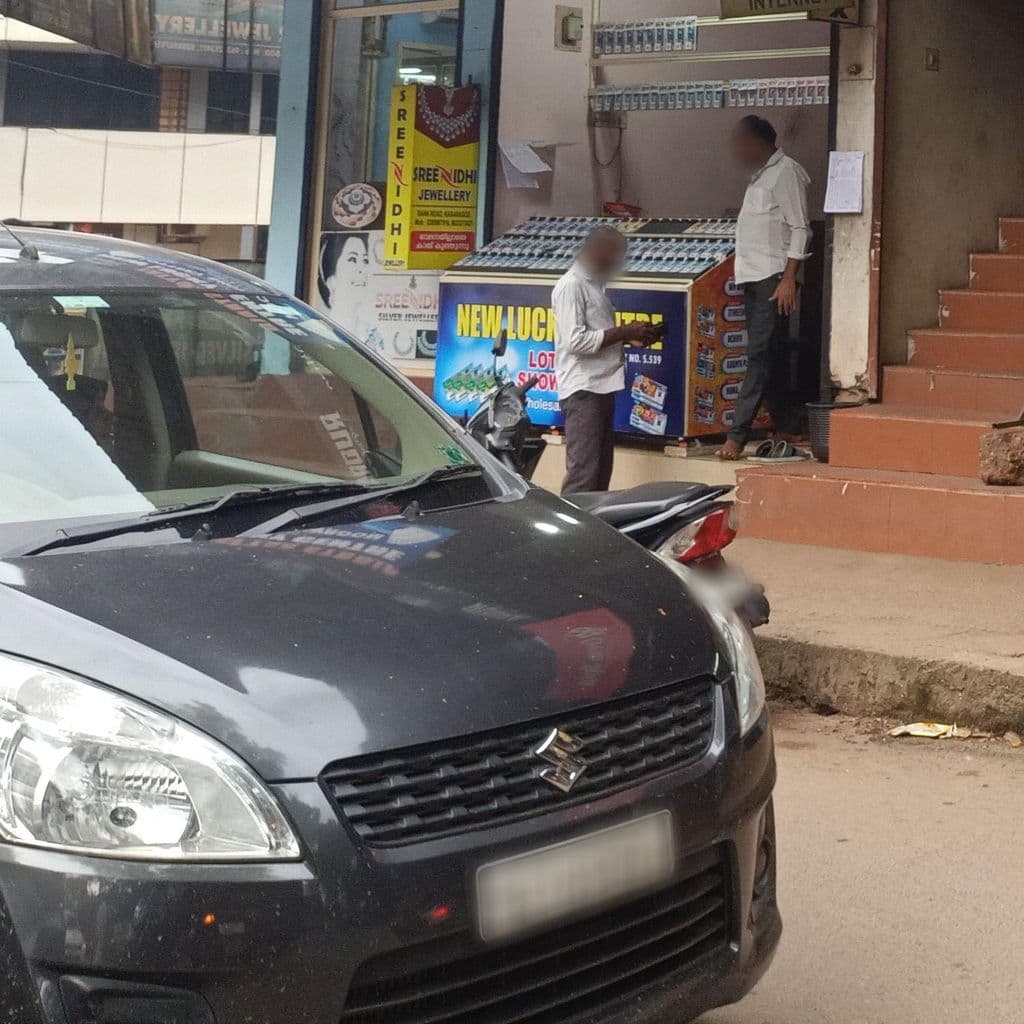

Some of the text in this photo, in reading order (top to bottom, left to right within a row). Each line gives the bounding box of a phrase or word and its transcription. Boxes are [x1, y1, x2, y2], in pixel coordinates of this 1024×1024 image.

[418, 189, 471, 202] JEWELLERY
[456, 303, 502, 338] NEW
[507, 304, 557, 342] LUC
[629, 354, 641, 363] NO.
[643, 354, 662, 365] S.539
